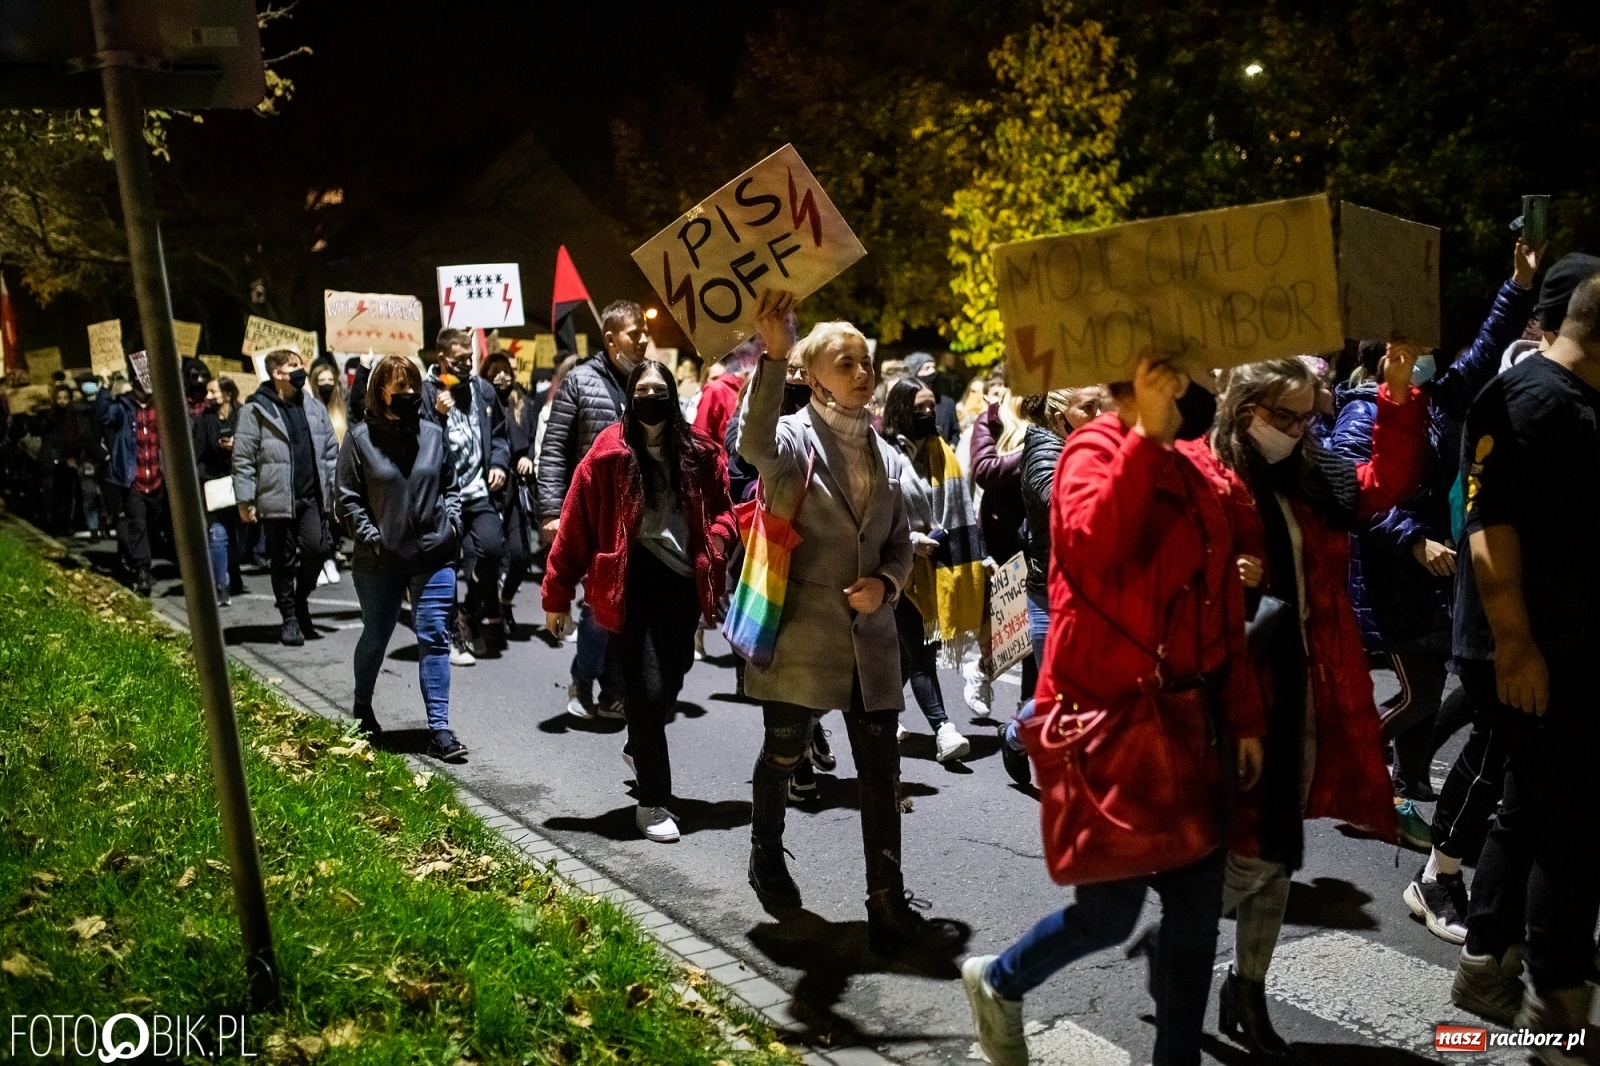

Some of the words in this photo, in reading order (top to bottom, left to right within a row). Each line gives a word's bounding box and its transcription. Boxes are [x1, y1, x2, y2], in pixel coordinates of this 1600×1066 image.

[677, 177, 782, 271] PIS
[698, 232, 802, 324] OFF
[248, 319, 300, 342] MEFEDRON
[999, 578, 1027, 606] SMALL
[995, 608, 1005, 626] IS
[1003, 608, 1029, 640] OMENS
[996, 638, 1025, 668] FIGHTING
